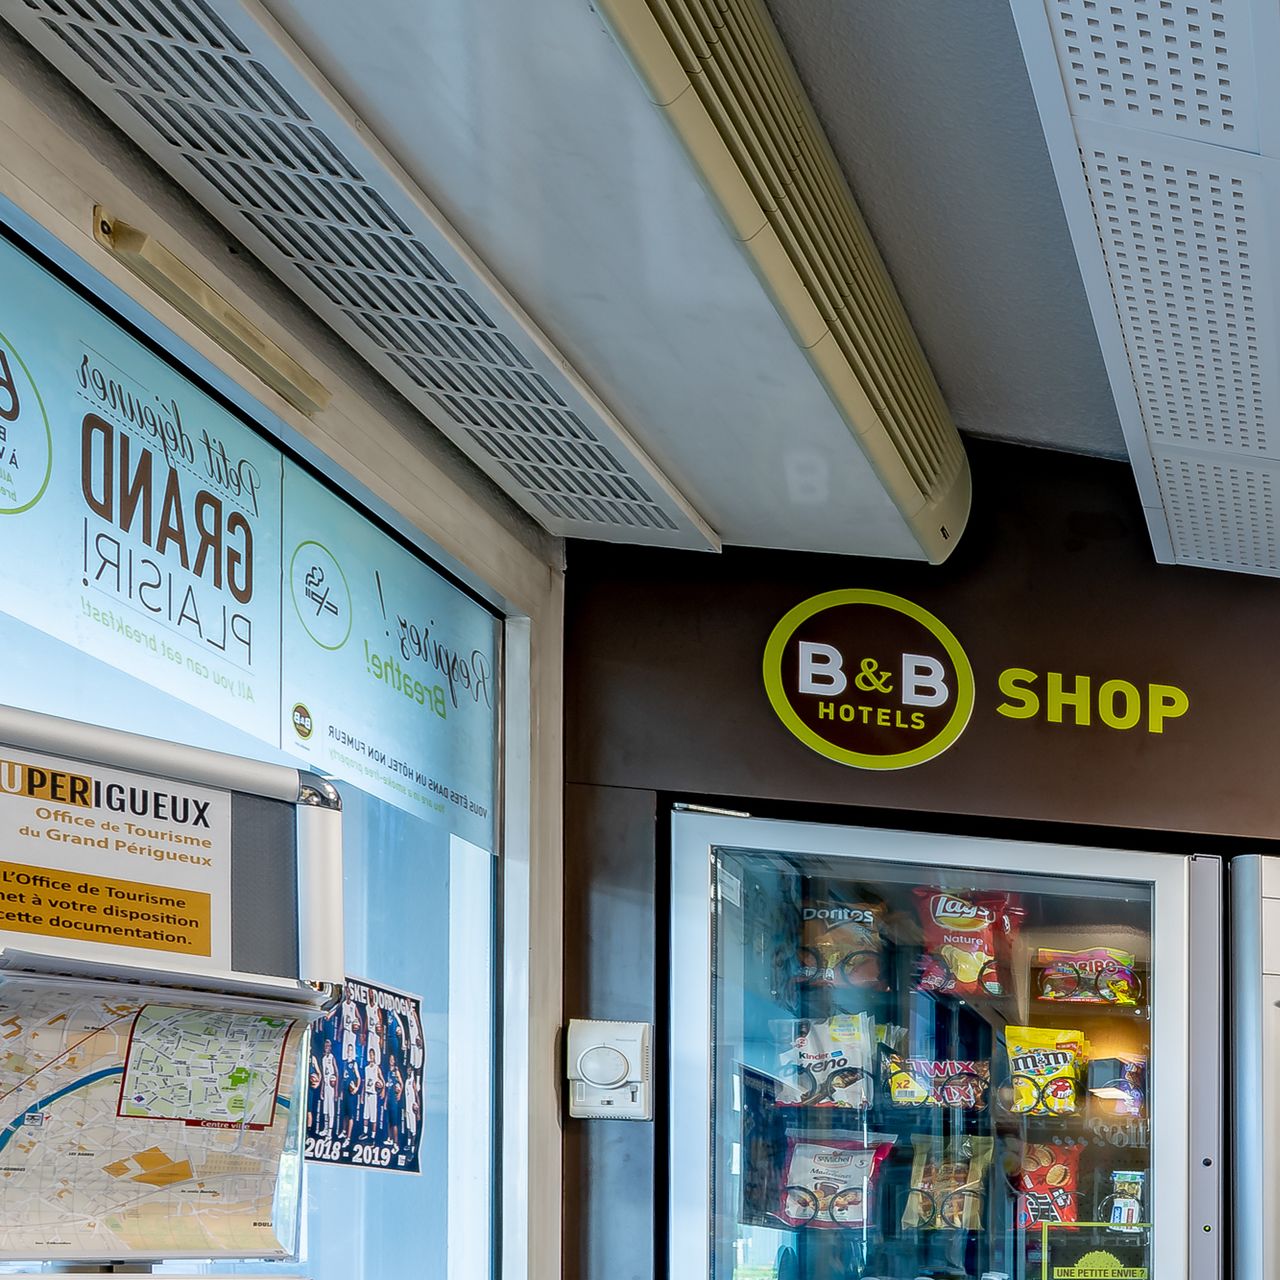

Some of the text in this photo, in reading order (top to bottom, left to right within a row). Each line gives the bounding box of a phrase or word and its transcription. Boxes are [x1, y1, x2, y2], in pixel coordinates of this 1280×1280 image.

[996, 667, 1190, 733] SHOP
[818, 702, 925, 730] HOTELS
[36, 807, 212, 849] Office de Tourisme
[19, 825, 212, 867] du Grand Périgueux
[3, 870, 186, 908] L'Office de Tourisme
[32, 894, 42, 906] à
[48, 899, 97, 914] votre
[103, 902, 199, 929] disposition
[803, 906, 873, 925] Doritos
[49, 916, 192, 945] documentation.
[943, 934, 983, 947] Nature
[907, 1059, 976, 1077] TWIX
[200, 1120, 250, 1131] Centre ville
[305, 1137, 341, 1159] 2018
[352, 1144, 391, 1166] 2019
[1056, 1268, 1145, 1278] UNE PETITE ENVIE ?
